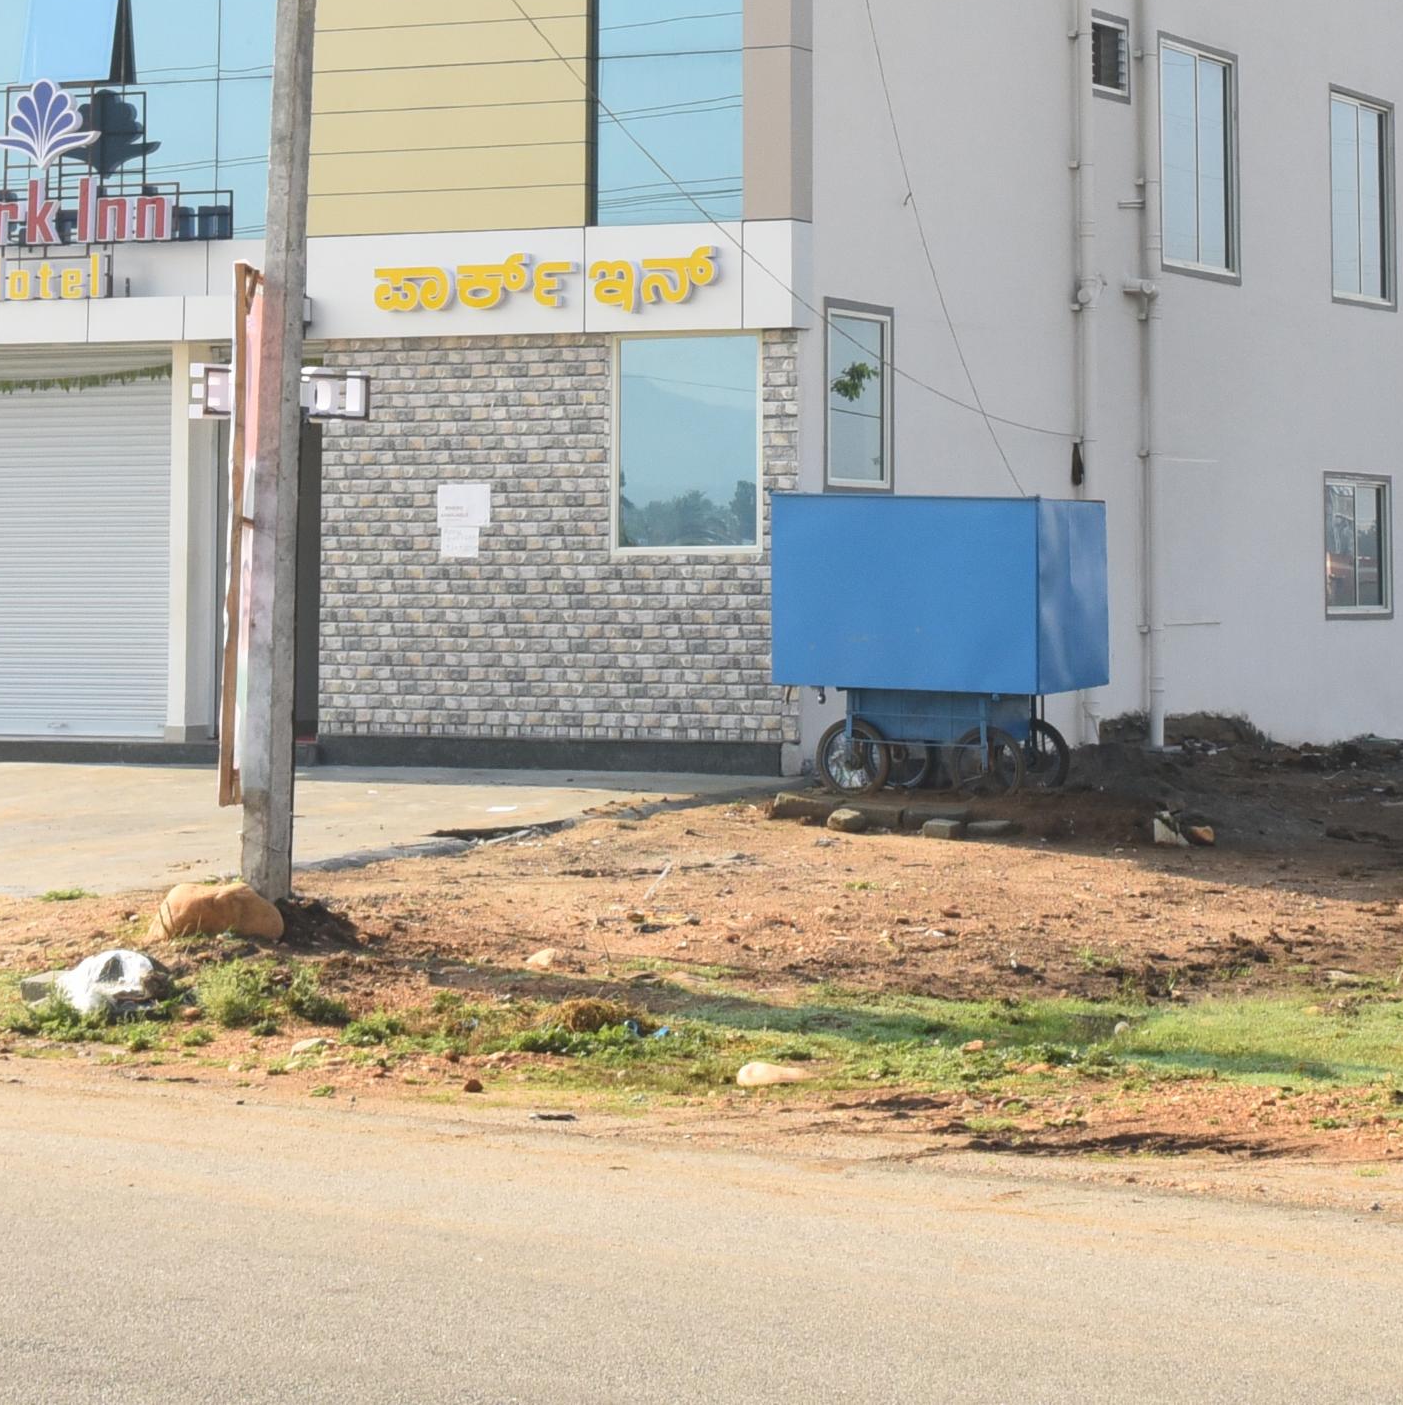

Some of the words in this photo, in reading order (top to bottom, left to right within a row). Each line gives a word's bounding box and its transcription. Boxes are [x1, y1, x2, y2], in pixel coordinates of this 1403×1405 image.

[76, 176, 172, 243] Inn
[374, 252, 578, 312] ಪಾರ್ಕ್
[588, 245, 720, 313] ಇನ್
